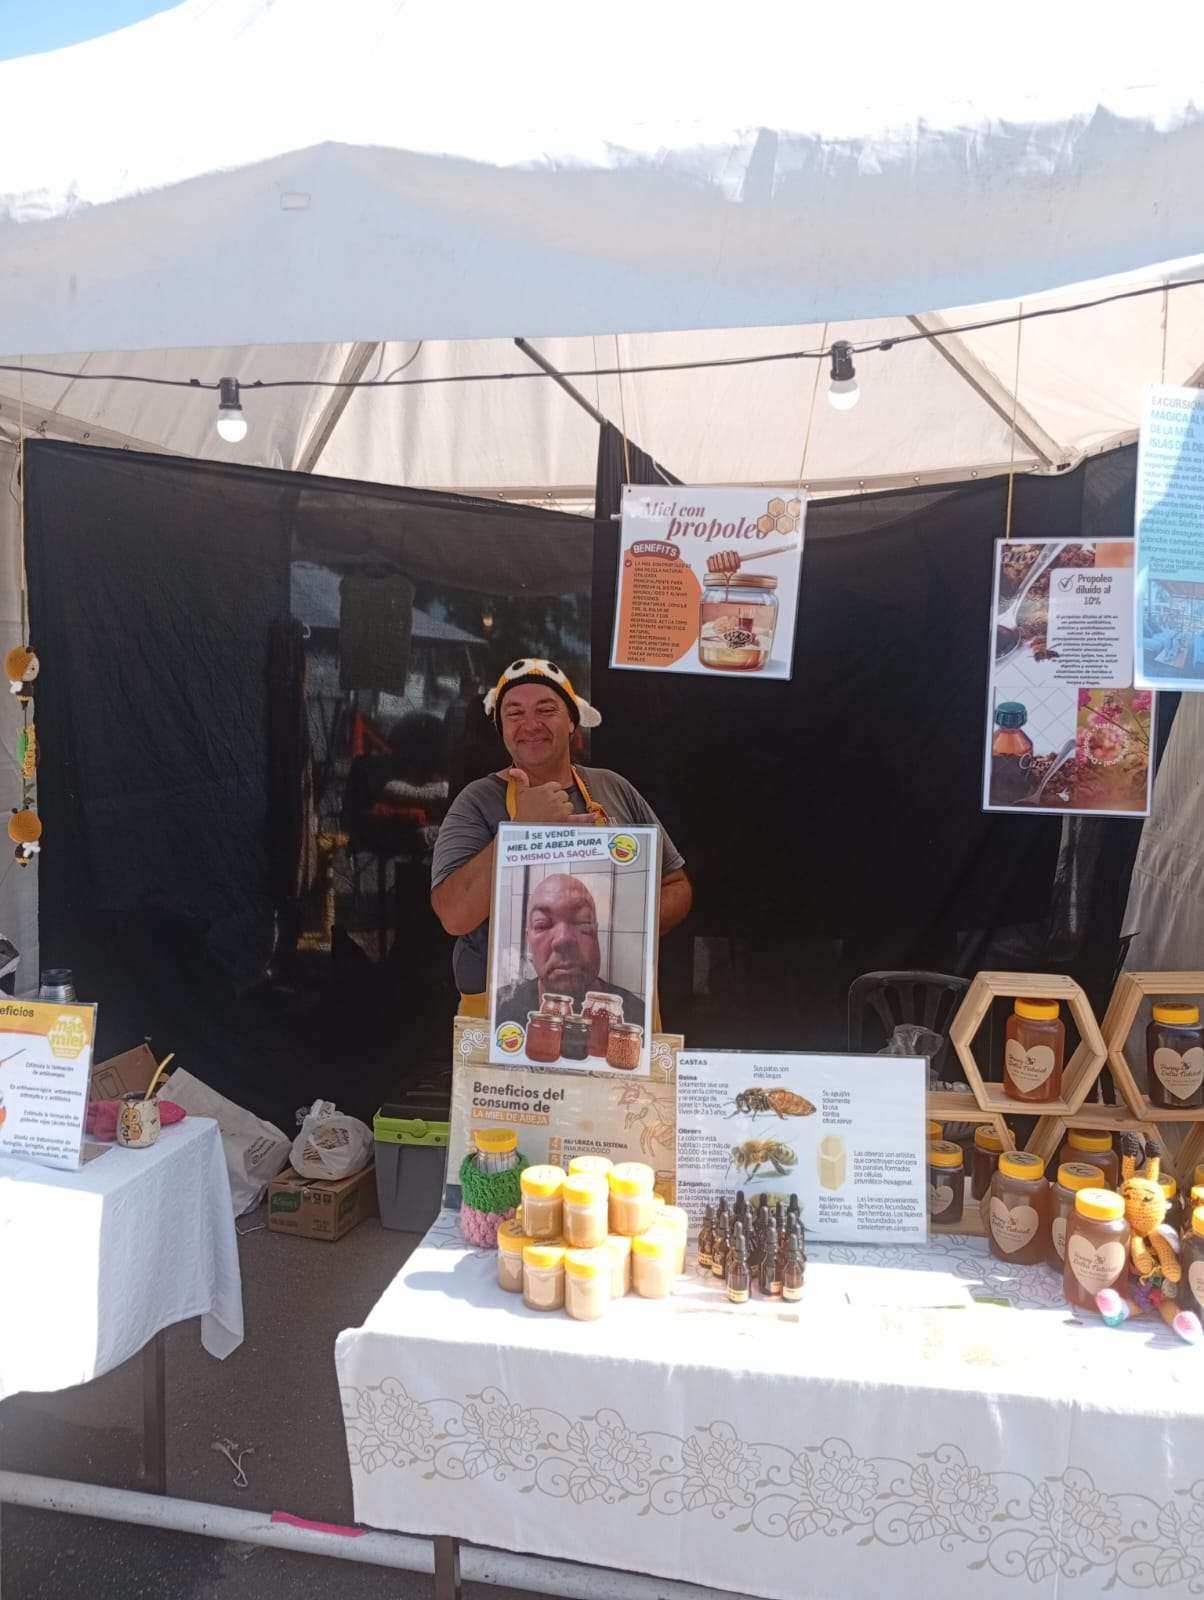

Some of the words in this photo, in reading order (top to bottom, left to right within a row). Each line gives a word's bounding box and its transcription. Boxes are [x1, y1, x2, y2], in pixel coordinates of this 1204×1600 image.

[680, 506, 705, 517] con
[633, 543, 677, 557] BENEFITS
[1103, 585, 1111, 594] al
[1083, 596, 1102, 605] 10%
[532, 832, 543, 840] SE
[544, 829, 576, 839] VENDE
[507, 843, 528, 852] MIEL
[530, 842, 543, 850] DE
[545, 839, 574, 849] ABEJA
[577, 838, 602, 847] PURA
[506, 854, 518, 863] YO
[520, 852, 551, 861] MISMO
[553, 851, 565, 859] LA
[473, 1081, 539, 1099] Beneficios
[542, 1088, 565, 1101] del
[472, 1097, 529, 1111] consumo
[533, 1100, 550, 1113] de
[472, 1109, 483, 1118] LA
[485, 1110, 504, 1120] MIEL
[506, 1112, 519, 1122] DE
[520, 1114, 549, 1125] ABEJA
